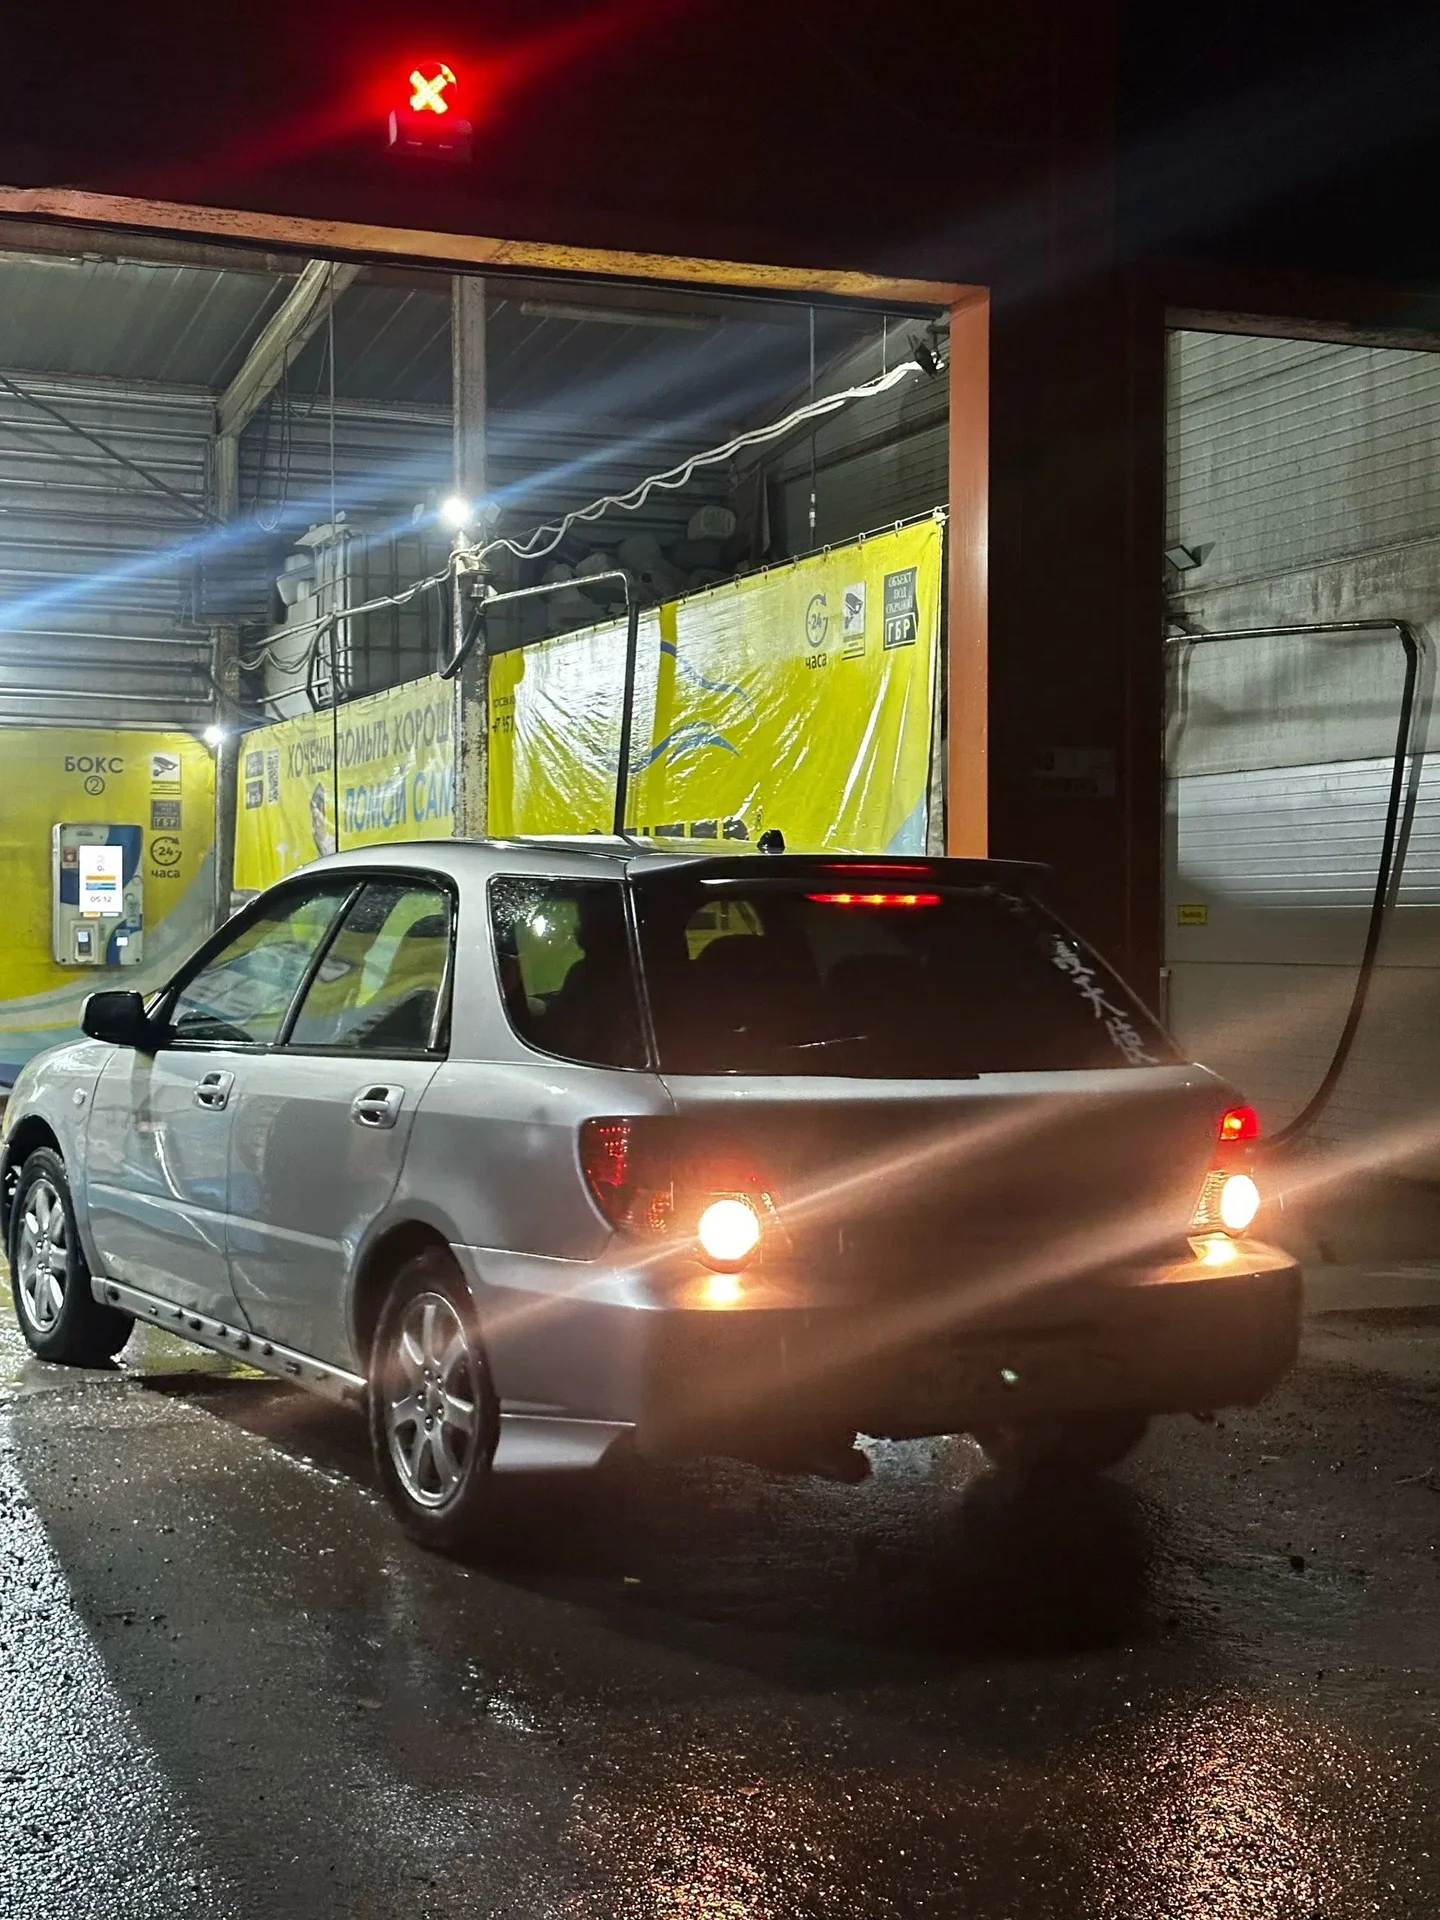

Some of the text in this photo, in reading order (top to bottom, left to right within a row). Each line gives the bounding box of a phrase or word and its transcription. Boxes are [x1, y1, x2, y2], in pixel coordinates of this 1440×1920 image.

[893, 586, 907, 600] ПОД
[811, 613, 823, 630] 24
[888, 617, 911, 643] ГБР
[805, 653, 827, 670] часа
[287, 735, 333, 779] ХОЧЕШЬ
[336, 720, 390, 769] ПОМЫТЬ
[393, 699, 456, 756] ХОРОШ
[64, 756, 124, 774] БОКС
[89, 779, 100, 792] 2
[158, 847, 174, 857] 24
[151, 869, 181, 879] часа
